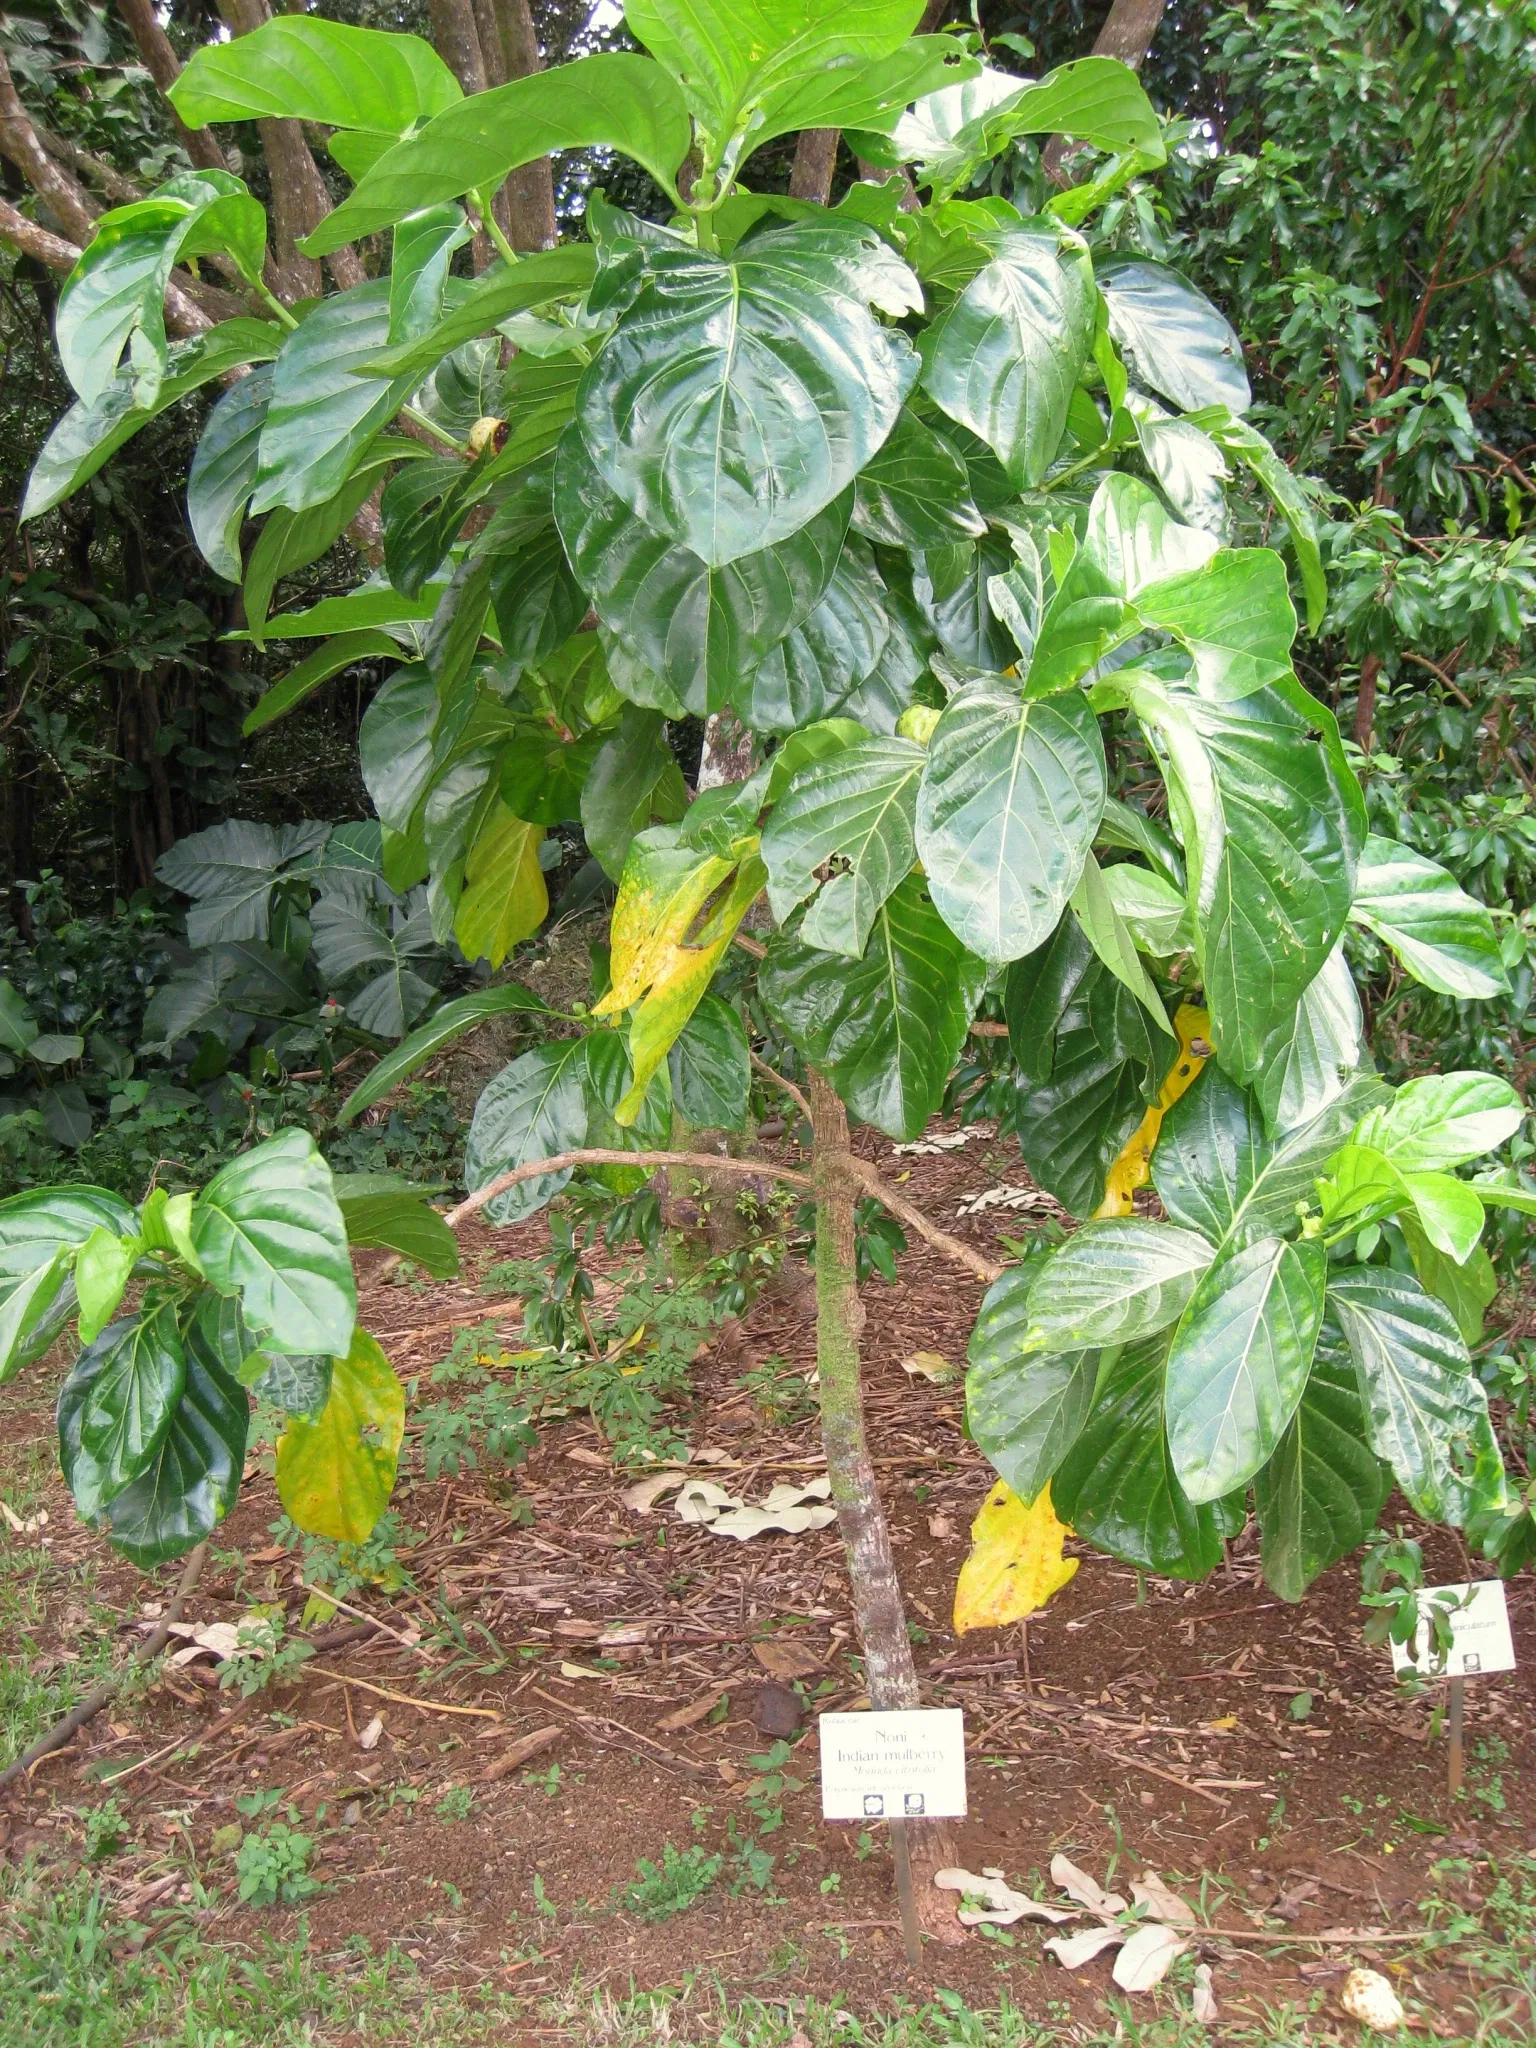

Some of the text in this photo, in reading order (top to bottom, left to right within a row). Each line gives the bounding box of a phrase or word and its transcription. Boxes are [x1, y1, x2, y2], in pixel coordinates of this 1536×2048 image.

[1451, 1620, 1497, 1632] aniculatum
[875, 1730, 908, 1743] Noni
[838, 1748, 945, 1763] Indian mulberry
